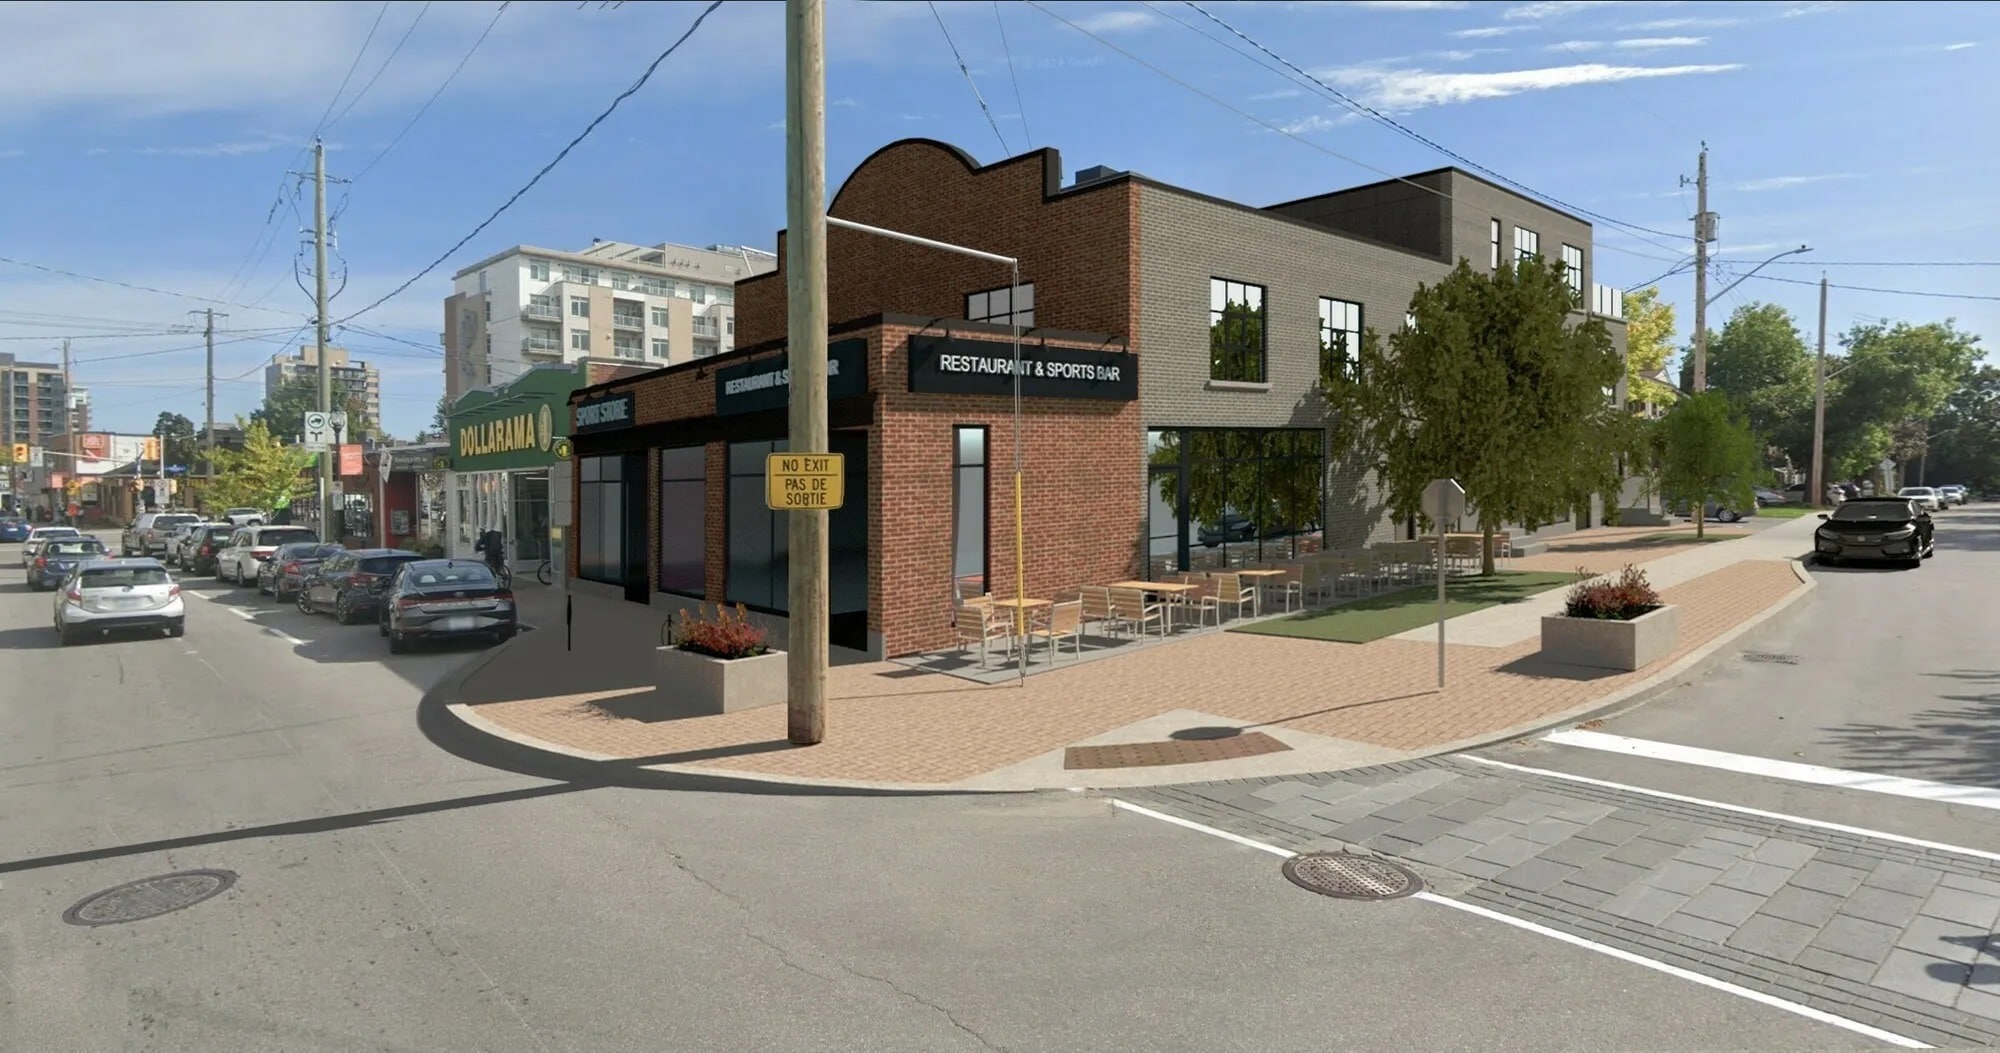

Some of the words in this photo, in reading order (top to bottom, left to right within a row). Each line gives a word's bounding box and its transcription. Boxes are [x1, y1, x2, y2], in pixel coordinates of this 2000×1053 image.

[940, 354, 1033, 376] RESTAURANT
[1035, 361, 1044, 377] &
[1046, 361, 1095, 380] SPORTS
[1096, 365, 1120, 382] BAR
[460, 412, 535, 457] DOLLARAMA
[782, 459, 799, 472] NO
[804, 457, 829, 472] EXIT
[785, 478, 806, 491] PAS
[812, 478, 827, 491] DE
[786, 492, 827, 506] SORTIE
